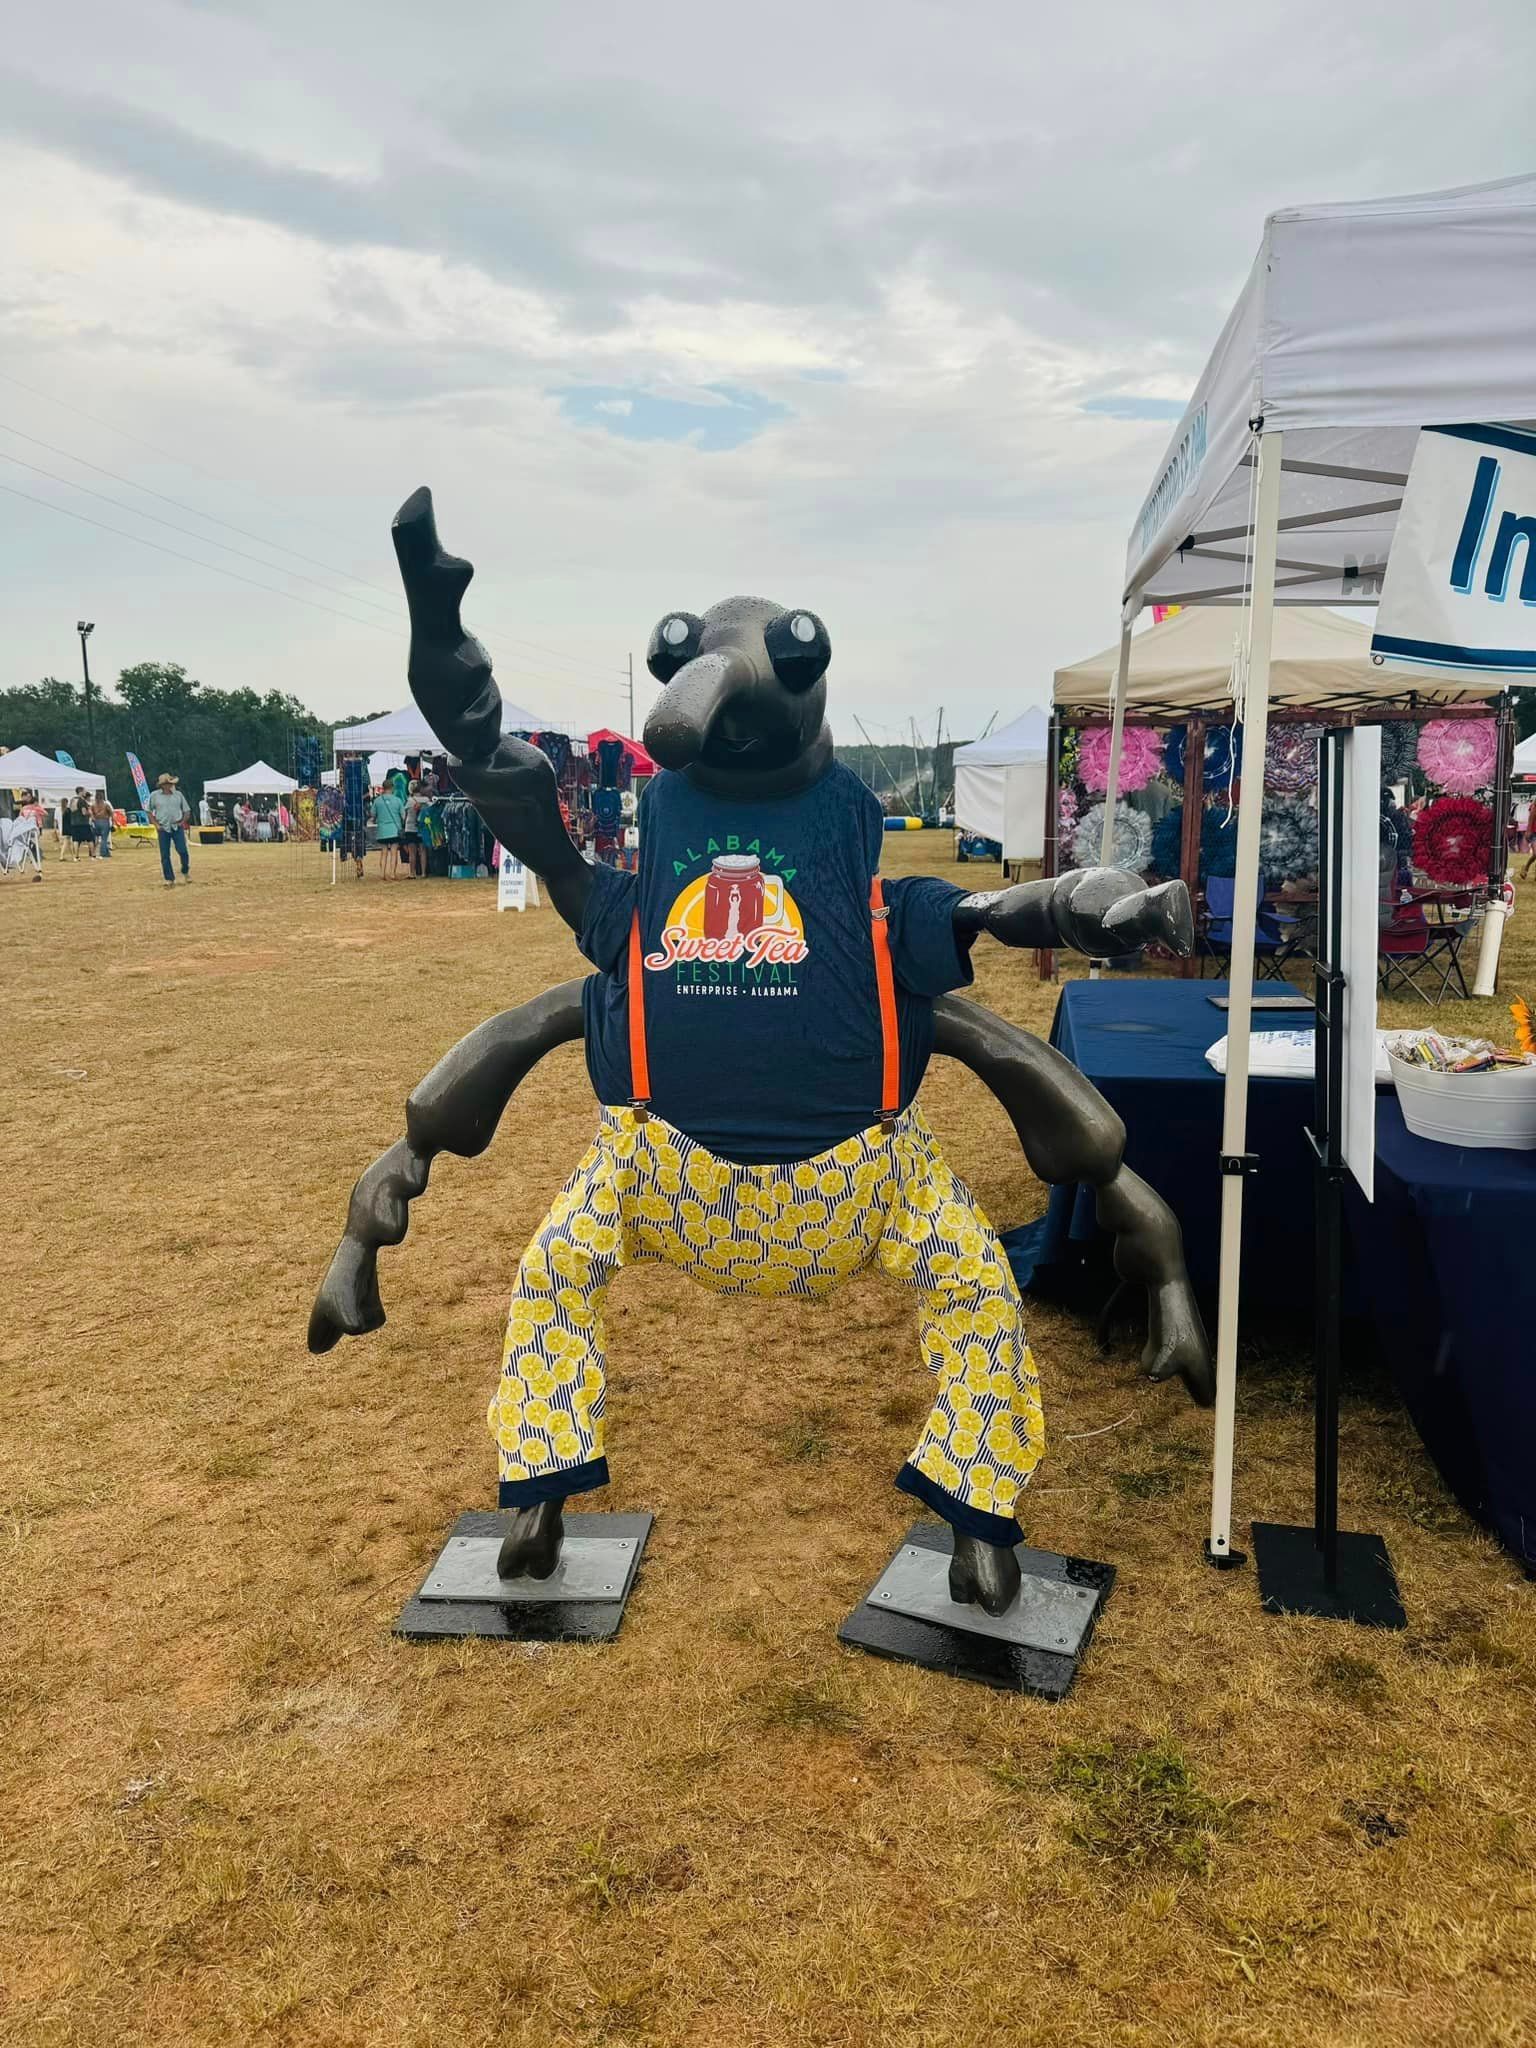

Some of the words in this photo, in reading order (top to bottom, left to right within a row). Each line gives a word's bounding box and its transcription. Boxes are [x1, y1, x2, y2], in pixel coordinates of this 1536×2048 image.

[672, 835, 798, 882] ALABAMA
[644, 927, 744, 971] Sweet
[745, 926, 809, 969] Tea
[676, 962, 798, 984] FESTIVAL
[676, 985, 738, 996] ENTERPRISE
[751, 986, 799, 997] ALABAMA
